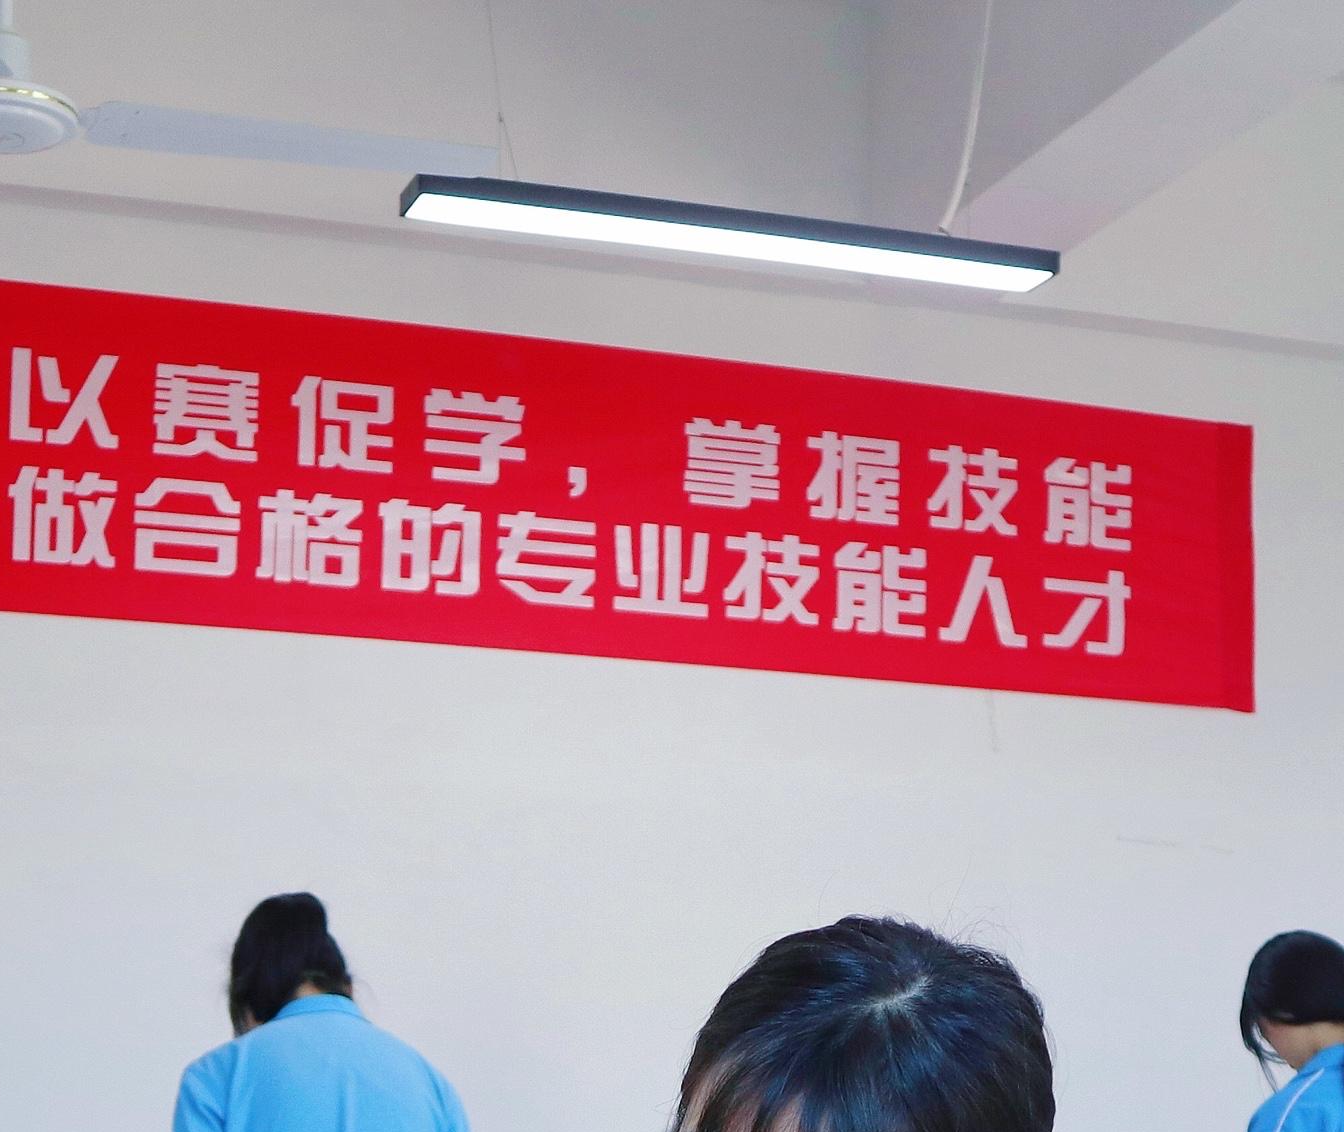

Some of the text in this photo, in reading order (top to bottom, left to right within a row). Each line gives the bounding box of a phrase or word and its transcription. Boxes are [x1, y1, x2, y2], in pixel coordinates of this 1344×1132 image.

[9, 346, 1134, 553] 以赛促学，掌握技能
[8, 464, 1133, 656] 做合格的专业技能人才
